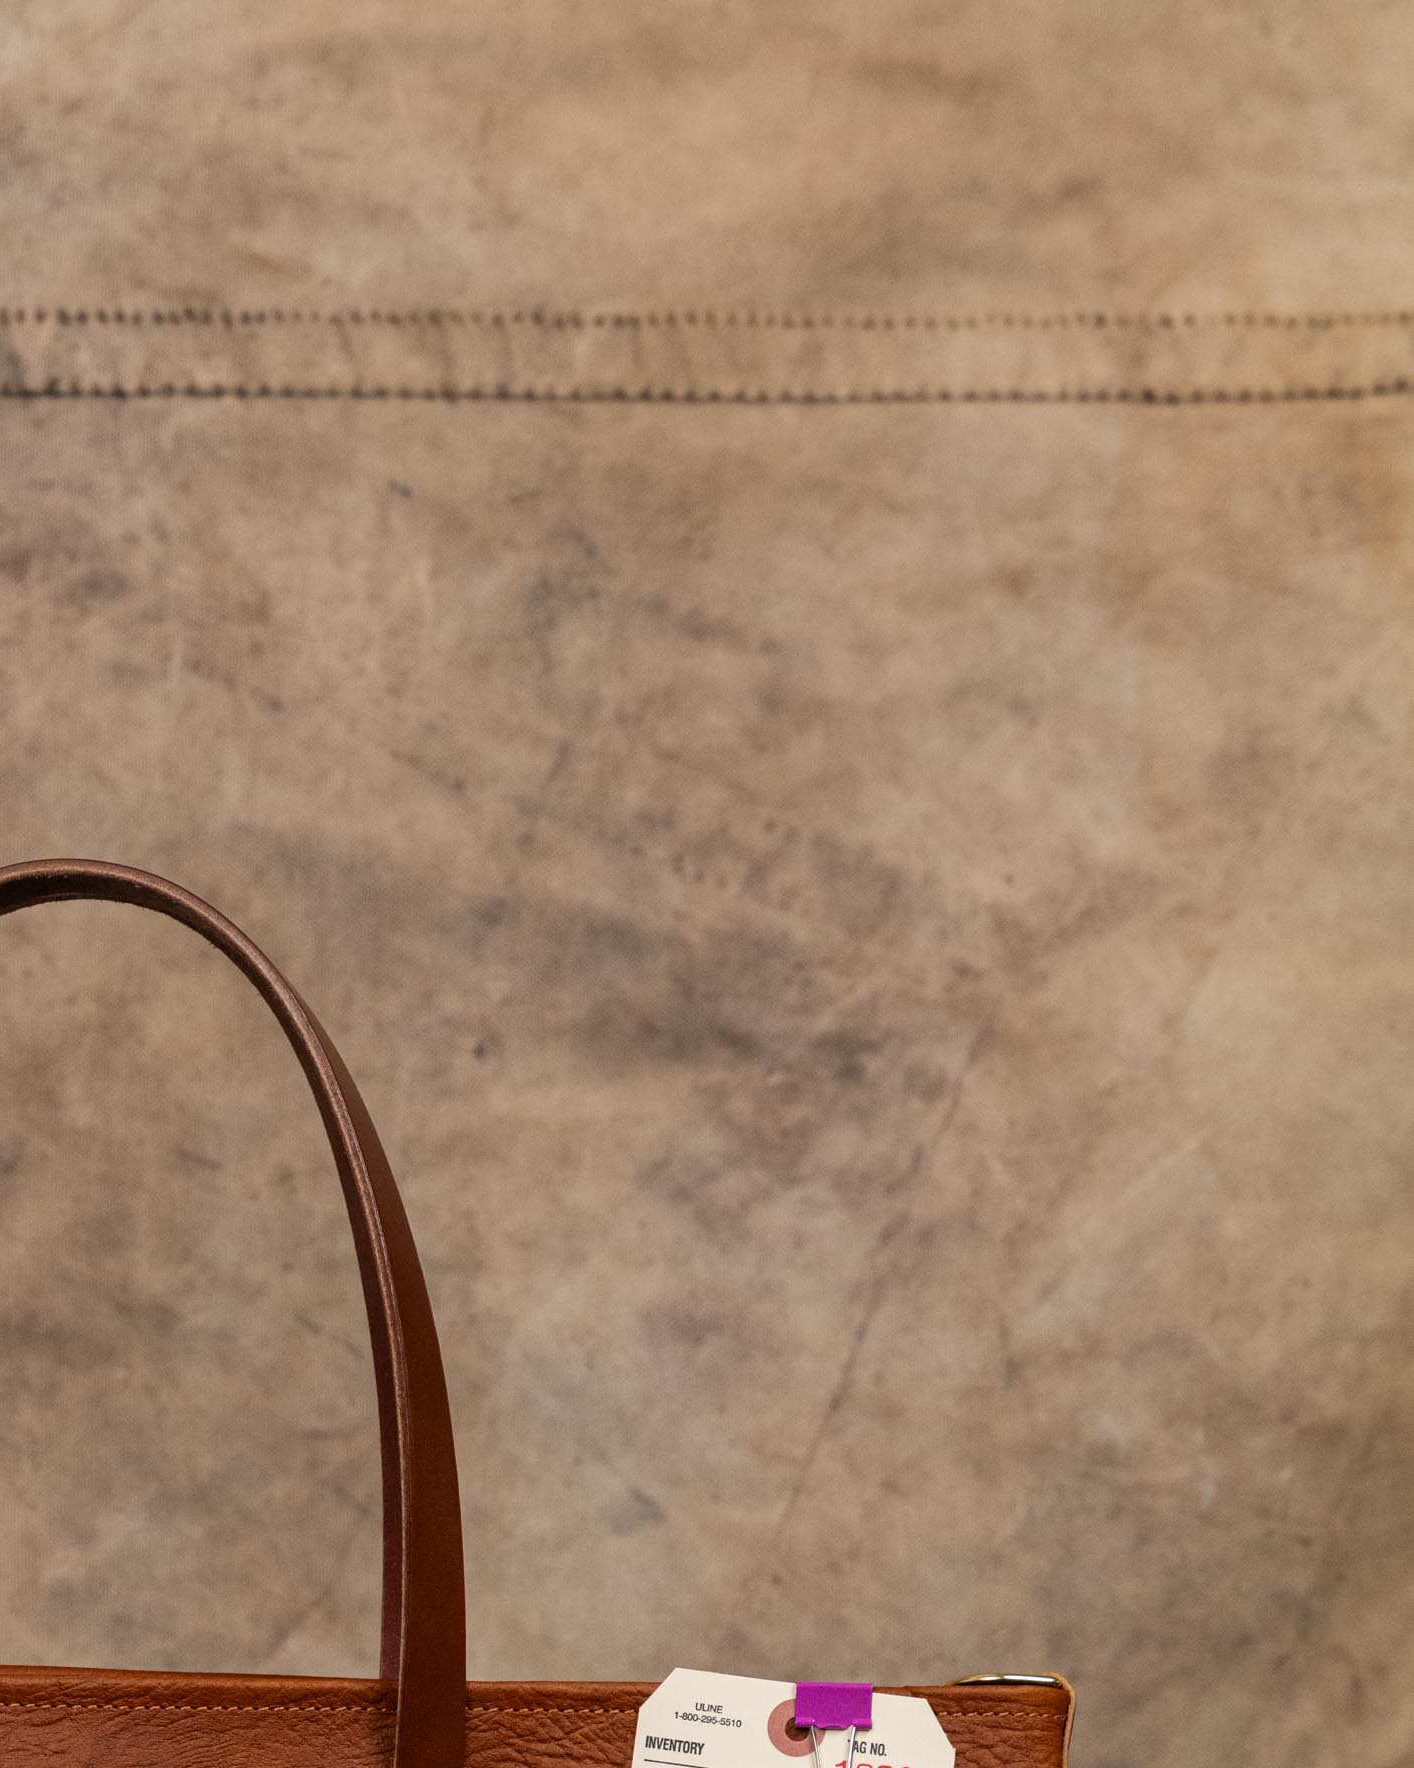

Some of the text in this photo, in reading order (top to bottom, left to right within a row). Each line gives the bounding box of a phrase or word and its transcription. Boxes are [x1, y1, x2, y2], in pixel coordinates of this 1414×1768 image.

[695, 1702, 723, 1714] ULINE
[674, 1711, 742, 1727] 1-800-295-5510
[644, 1735, 704, 1755] INVENTORY
[847, 1738, 886, 1756] AG NO.
